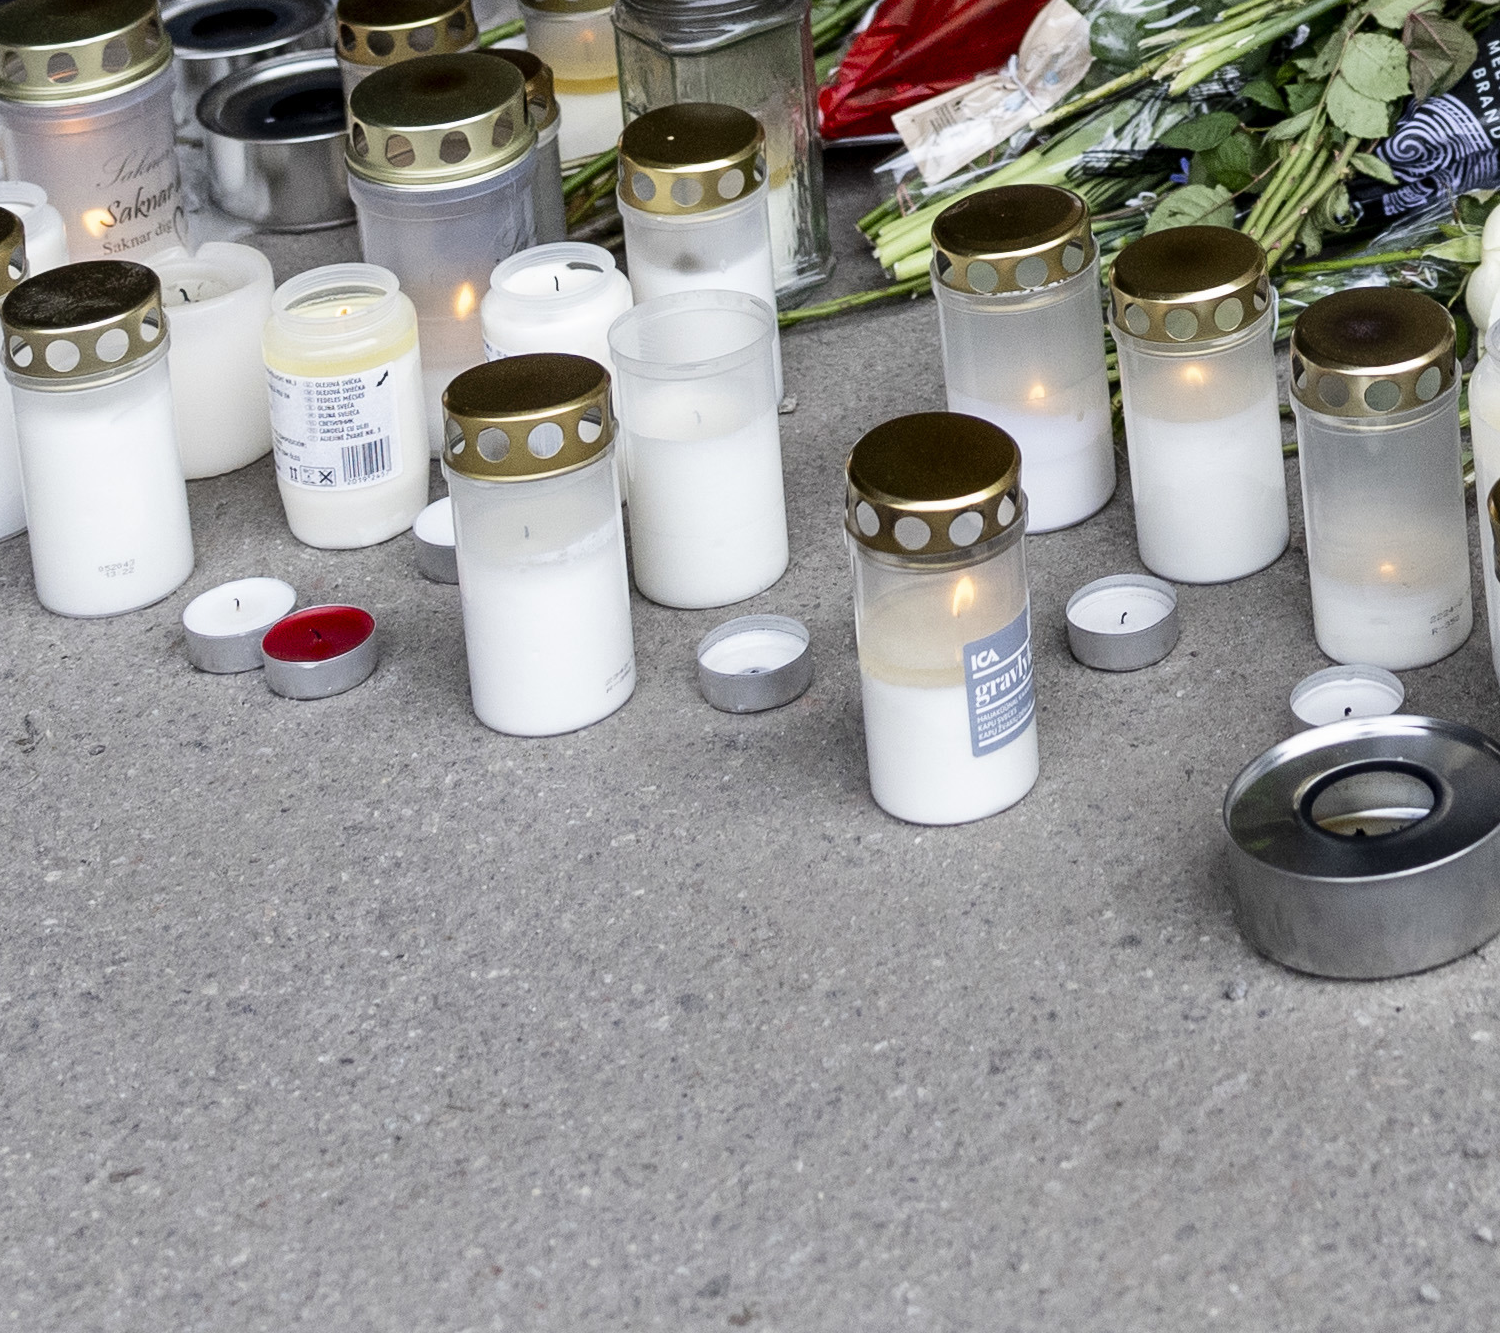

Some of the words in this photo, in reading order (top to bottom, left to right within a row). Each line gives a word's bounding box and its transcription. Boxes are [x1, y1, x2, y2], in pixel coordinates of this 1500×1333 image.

[99, 185, 175, 229] Saknar
[103, 230, 152, 256] Saknar
[970, 648, 1000, 672] ICA
